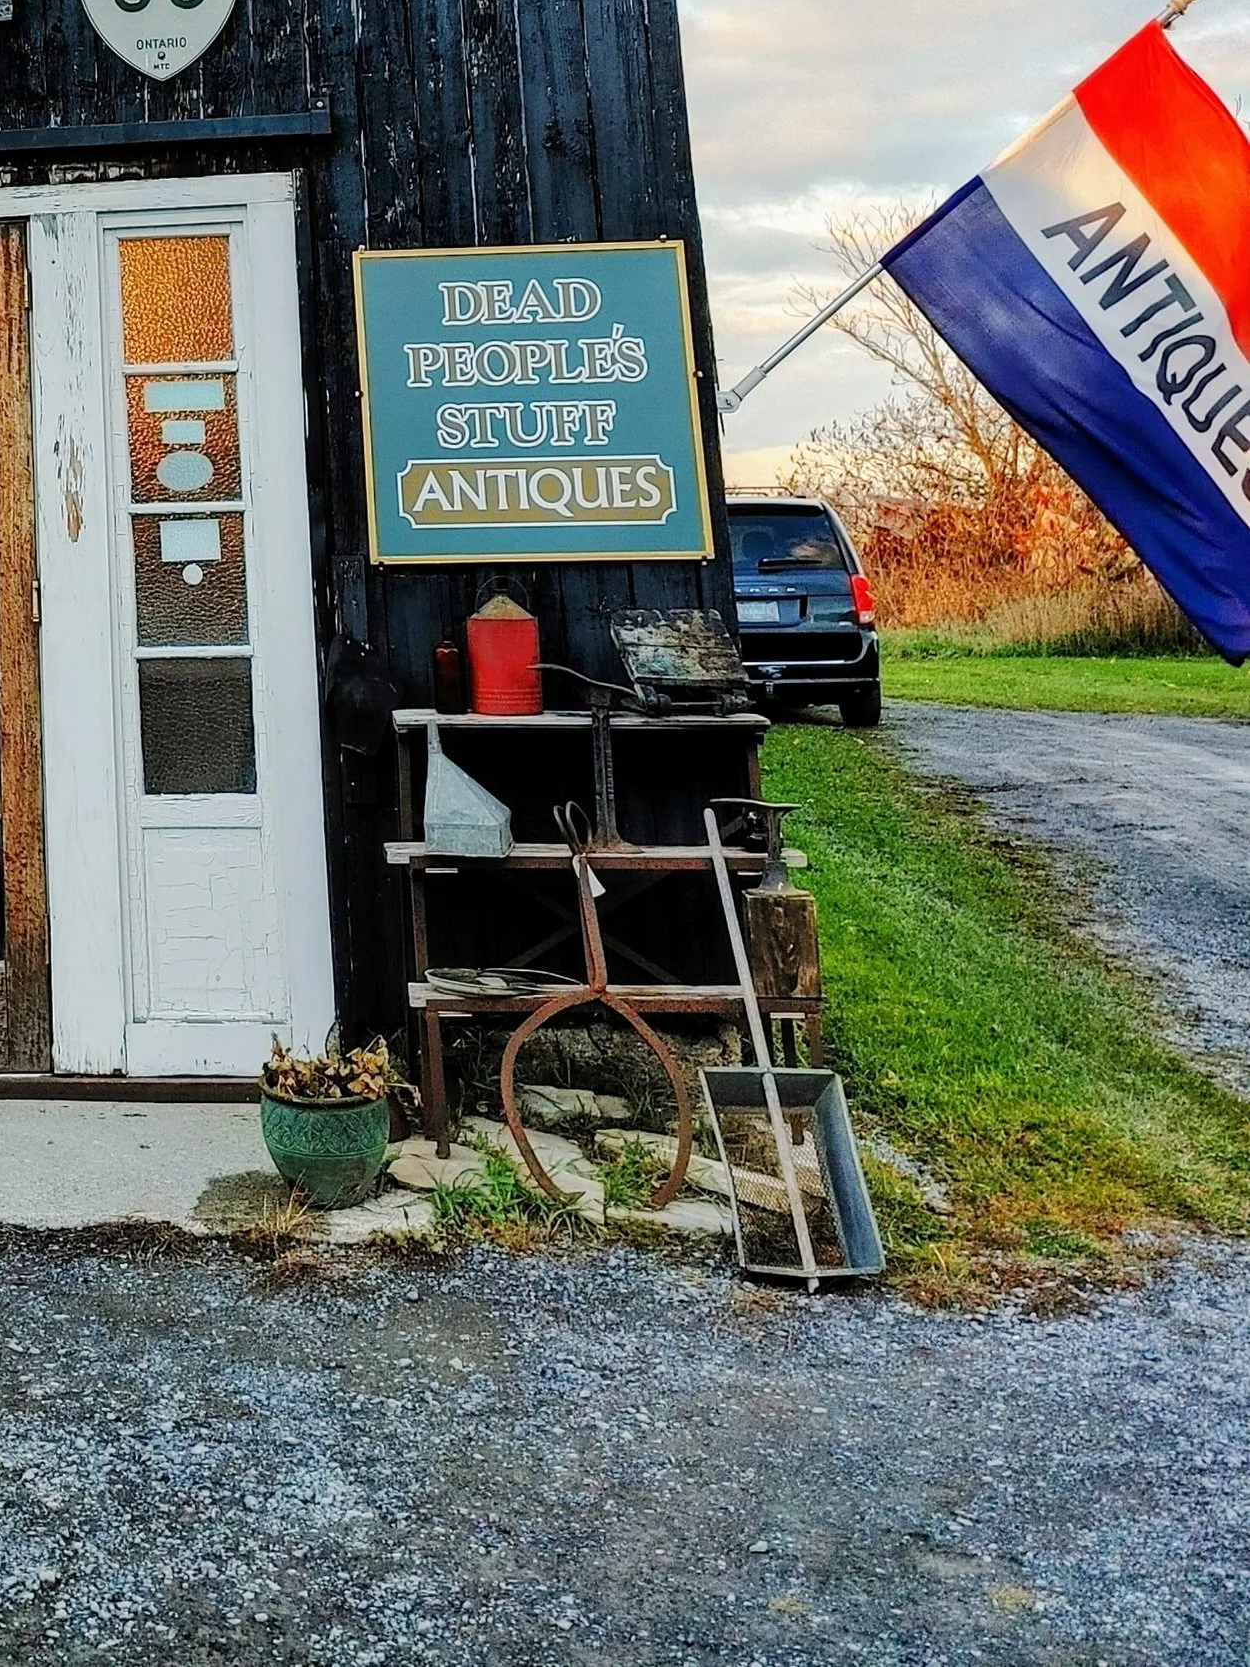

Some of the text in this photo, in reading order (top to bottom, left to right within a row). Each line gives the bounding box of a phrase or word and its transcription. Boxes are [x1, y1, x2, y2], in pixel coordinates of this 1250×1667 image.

[136, 37, 187, 50] ONTARIO
[438, 277, 602, 327] DEAD
[403, 322, 649, 388] PEOPLE'S
[436, 399, 617, 450] STUFF
[412, 466, 662, 517] ANTIQUES
